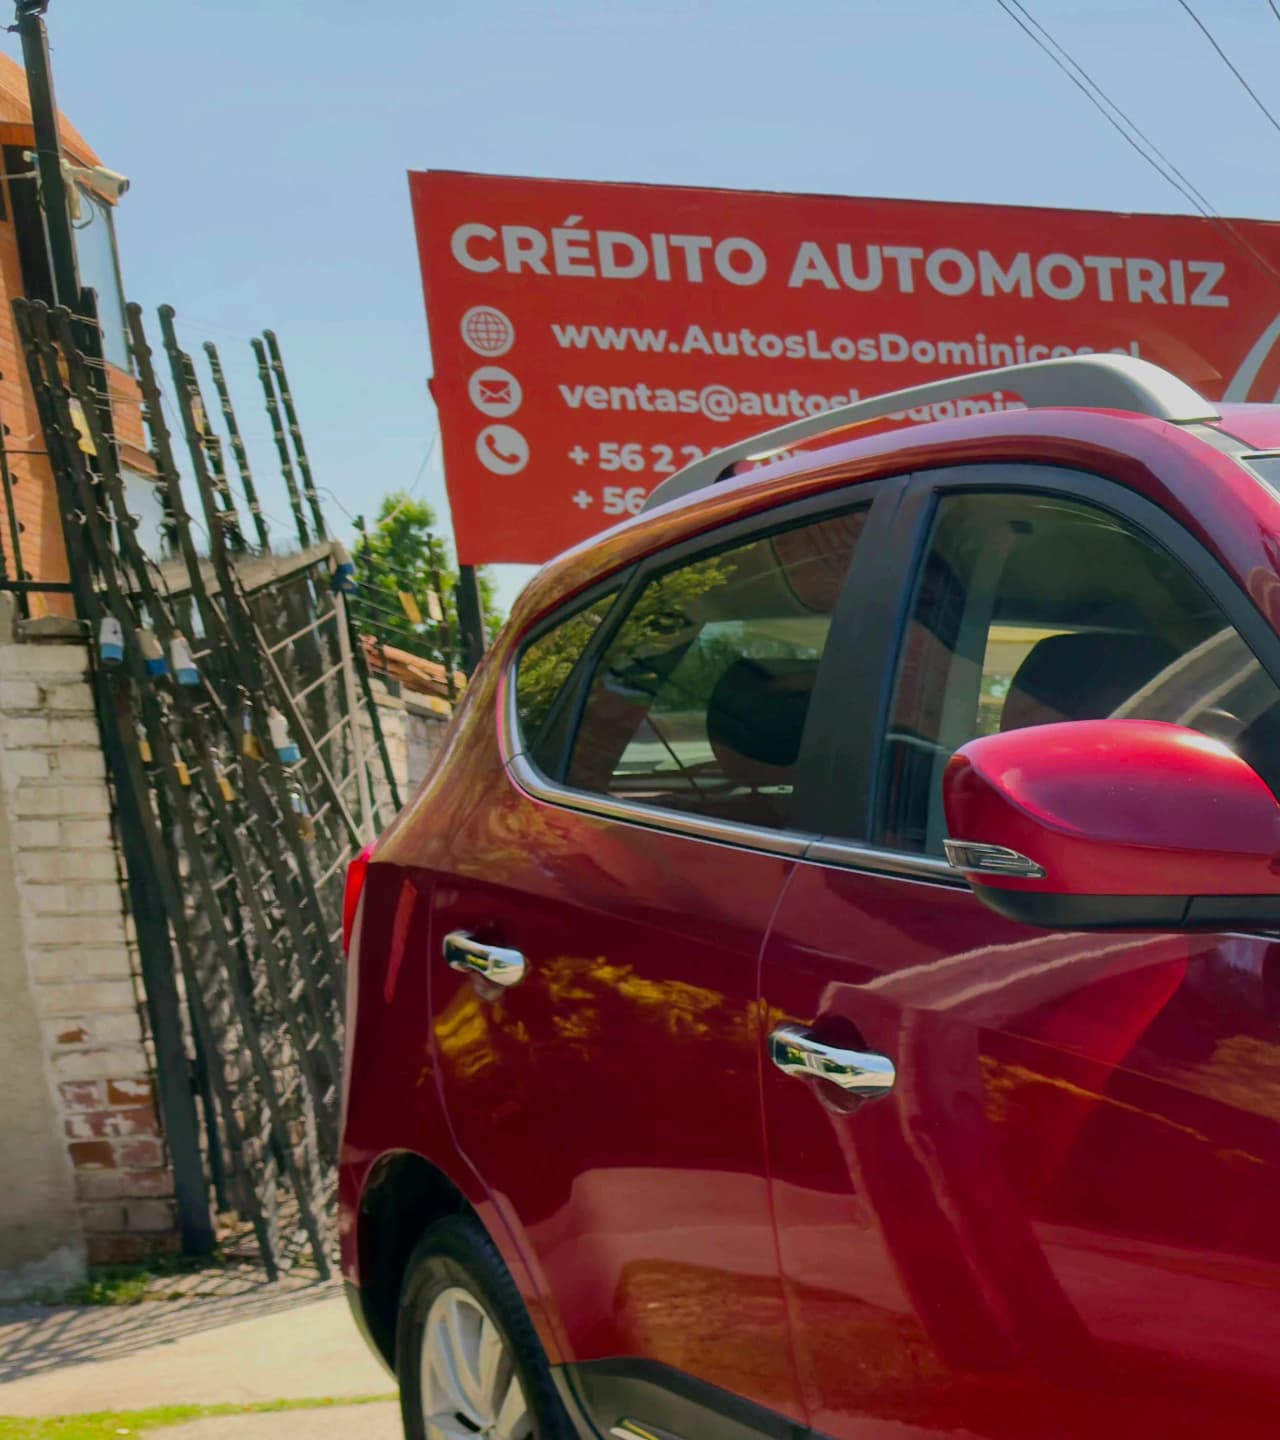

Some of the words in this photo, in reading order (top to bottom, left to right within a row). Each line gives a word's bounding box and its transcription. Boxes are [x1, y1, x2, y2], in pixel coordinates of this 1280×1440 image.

[451, 215, 767, 286] CRÉDITO
[787, 241, 1229, 307] AUTOMOTRIZ
[551, 324, 1140, 367] www.AutosLosDominicol
[598, 442, 646, 472] 56
[650, 444, 677, 473] 2
[602, 486, 647, 516] 56
